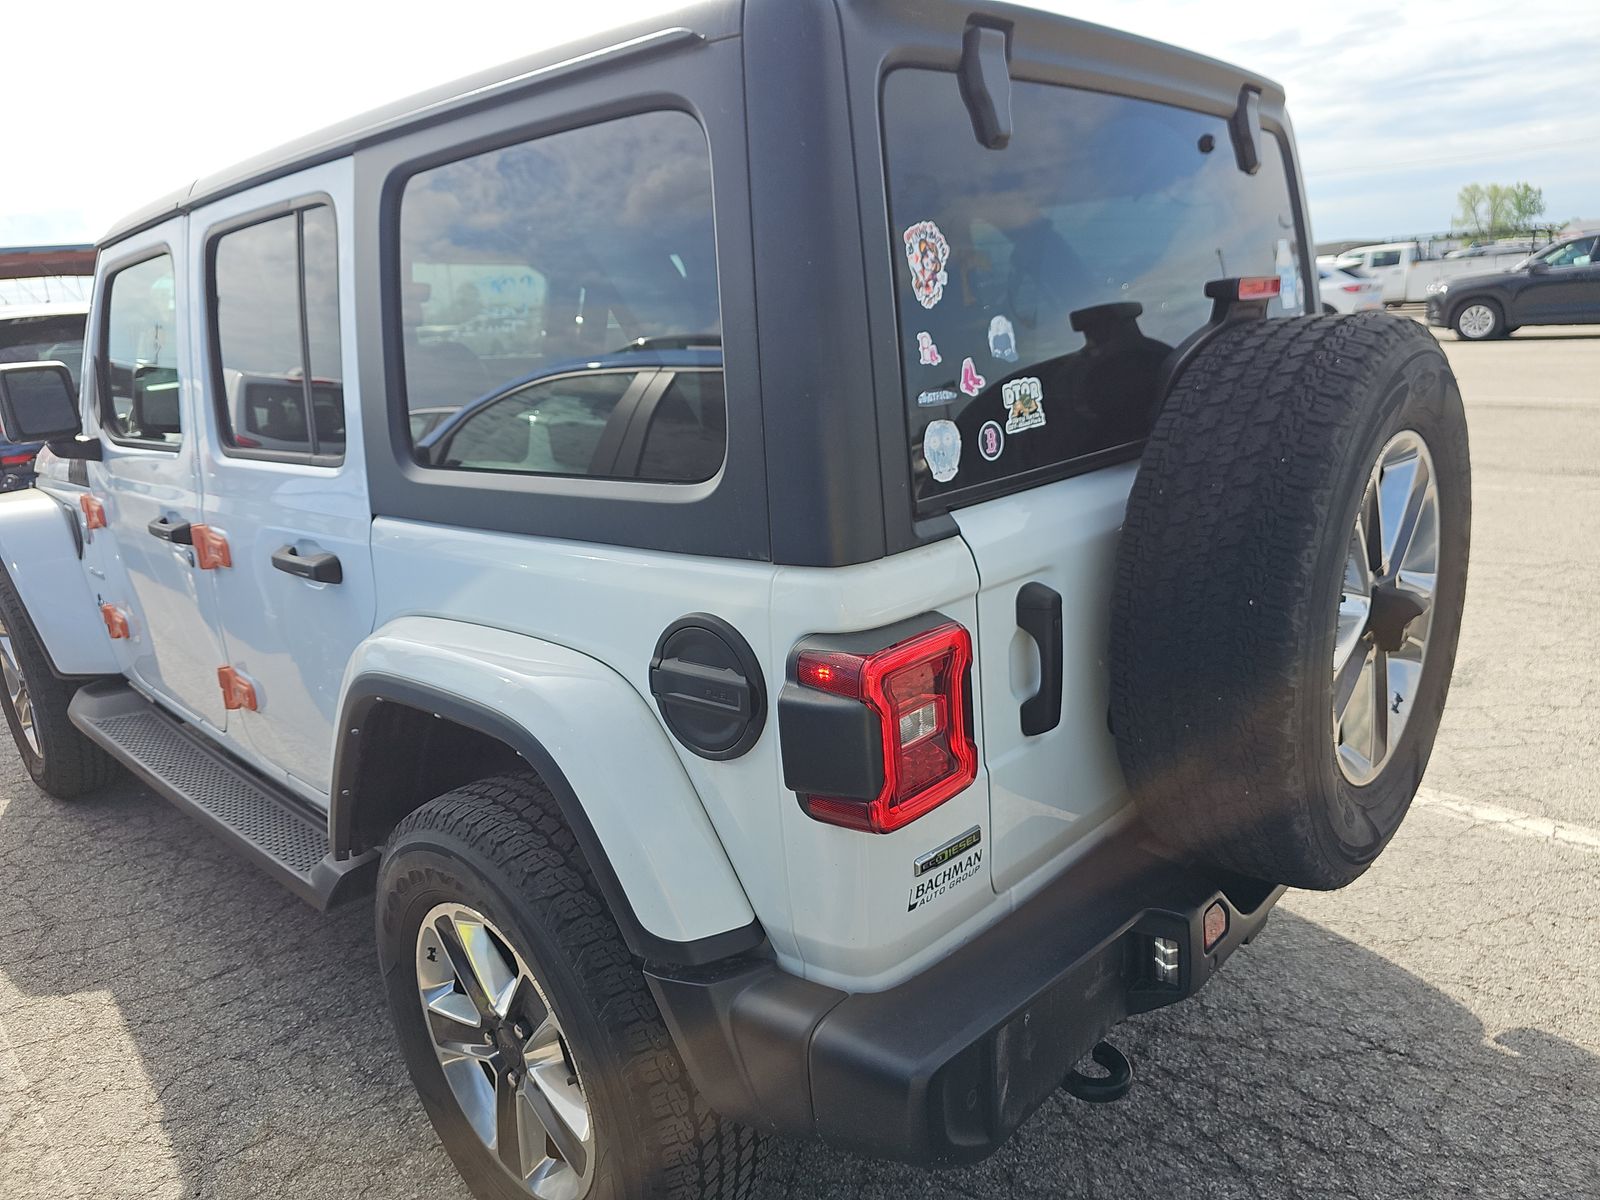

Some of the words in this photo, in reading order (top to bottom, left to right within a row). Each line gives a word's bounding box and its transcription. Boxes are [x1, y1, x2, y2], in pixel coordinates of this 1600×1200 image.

[915, 849, 983, 899] BACHMAN
[918, 886, 946, 907] AUTO
[949, 864, 981, 889] GROUP
